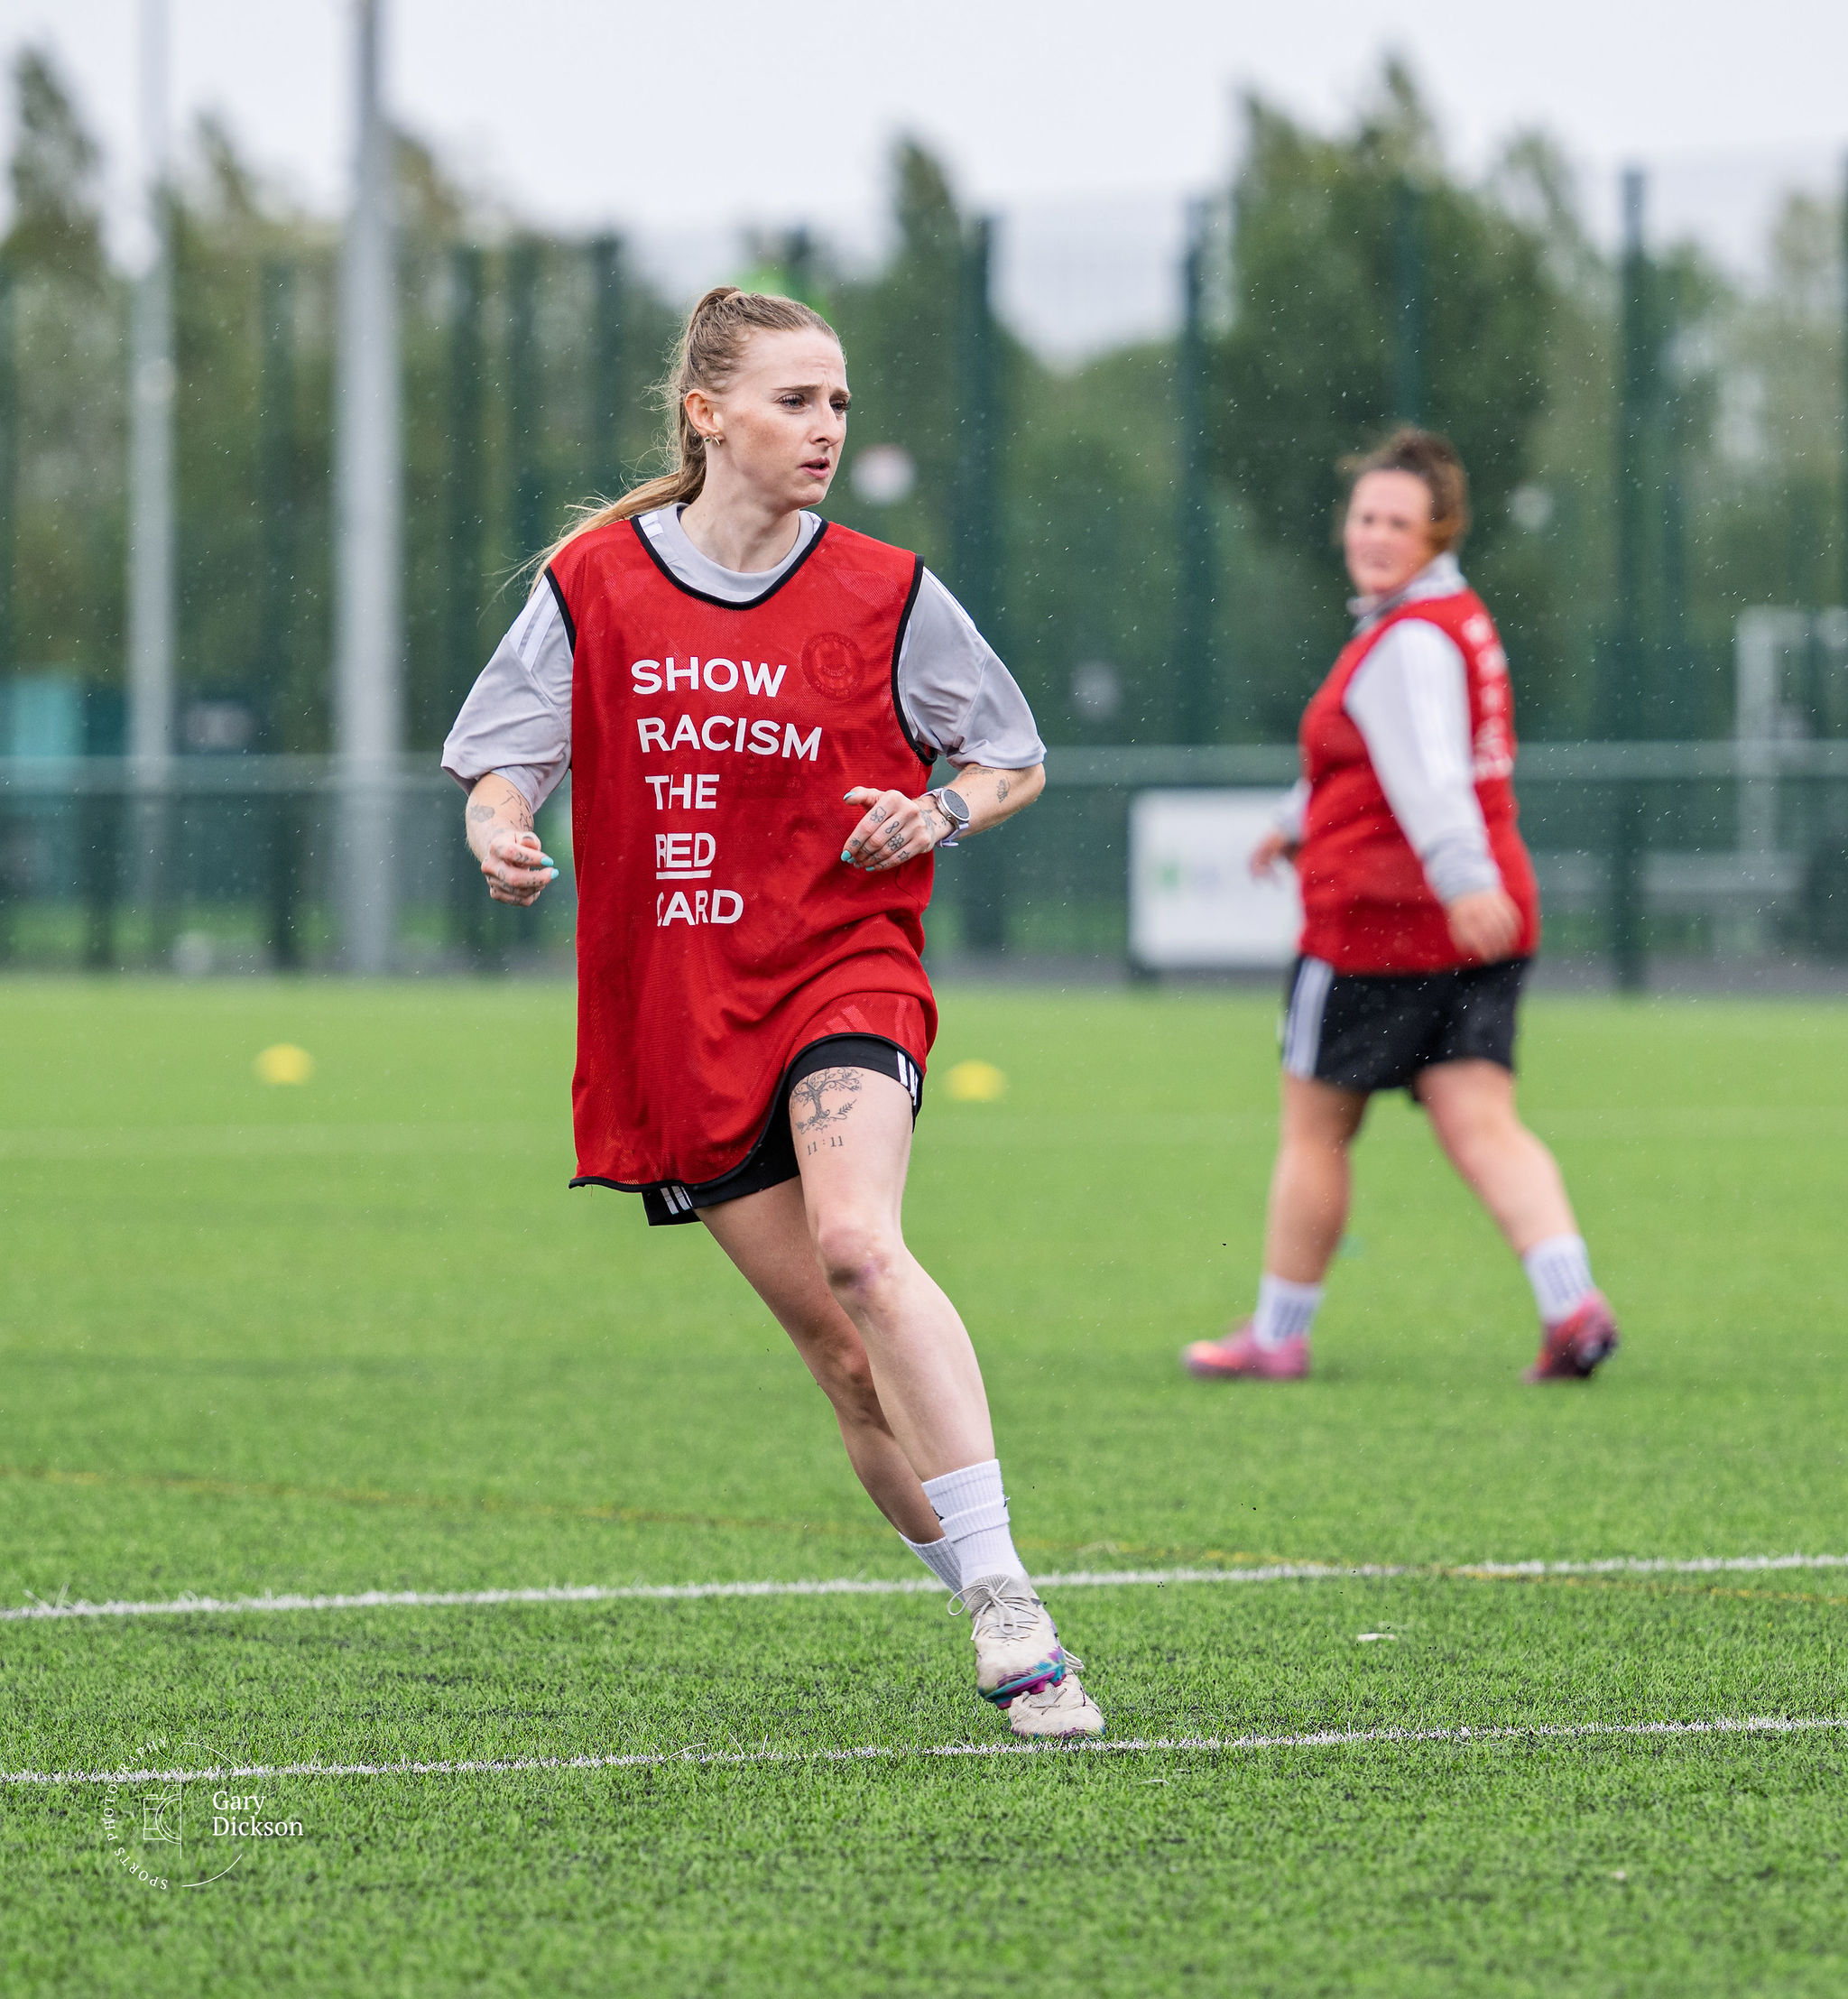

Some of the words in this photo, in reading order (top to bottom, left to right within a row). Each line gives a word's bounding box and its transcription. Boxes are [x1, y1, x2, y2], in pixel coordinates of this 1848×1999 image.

[632, 656, 787, 697] SHOW
[636, 714, 822, 761] RACISM
[645, 773, 719, 810] THE
[655, 832, 716, 868] RED
